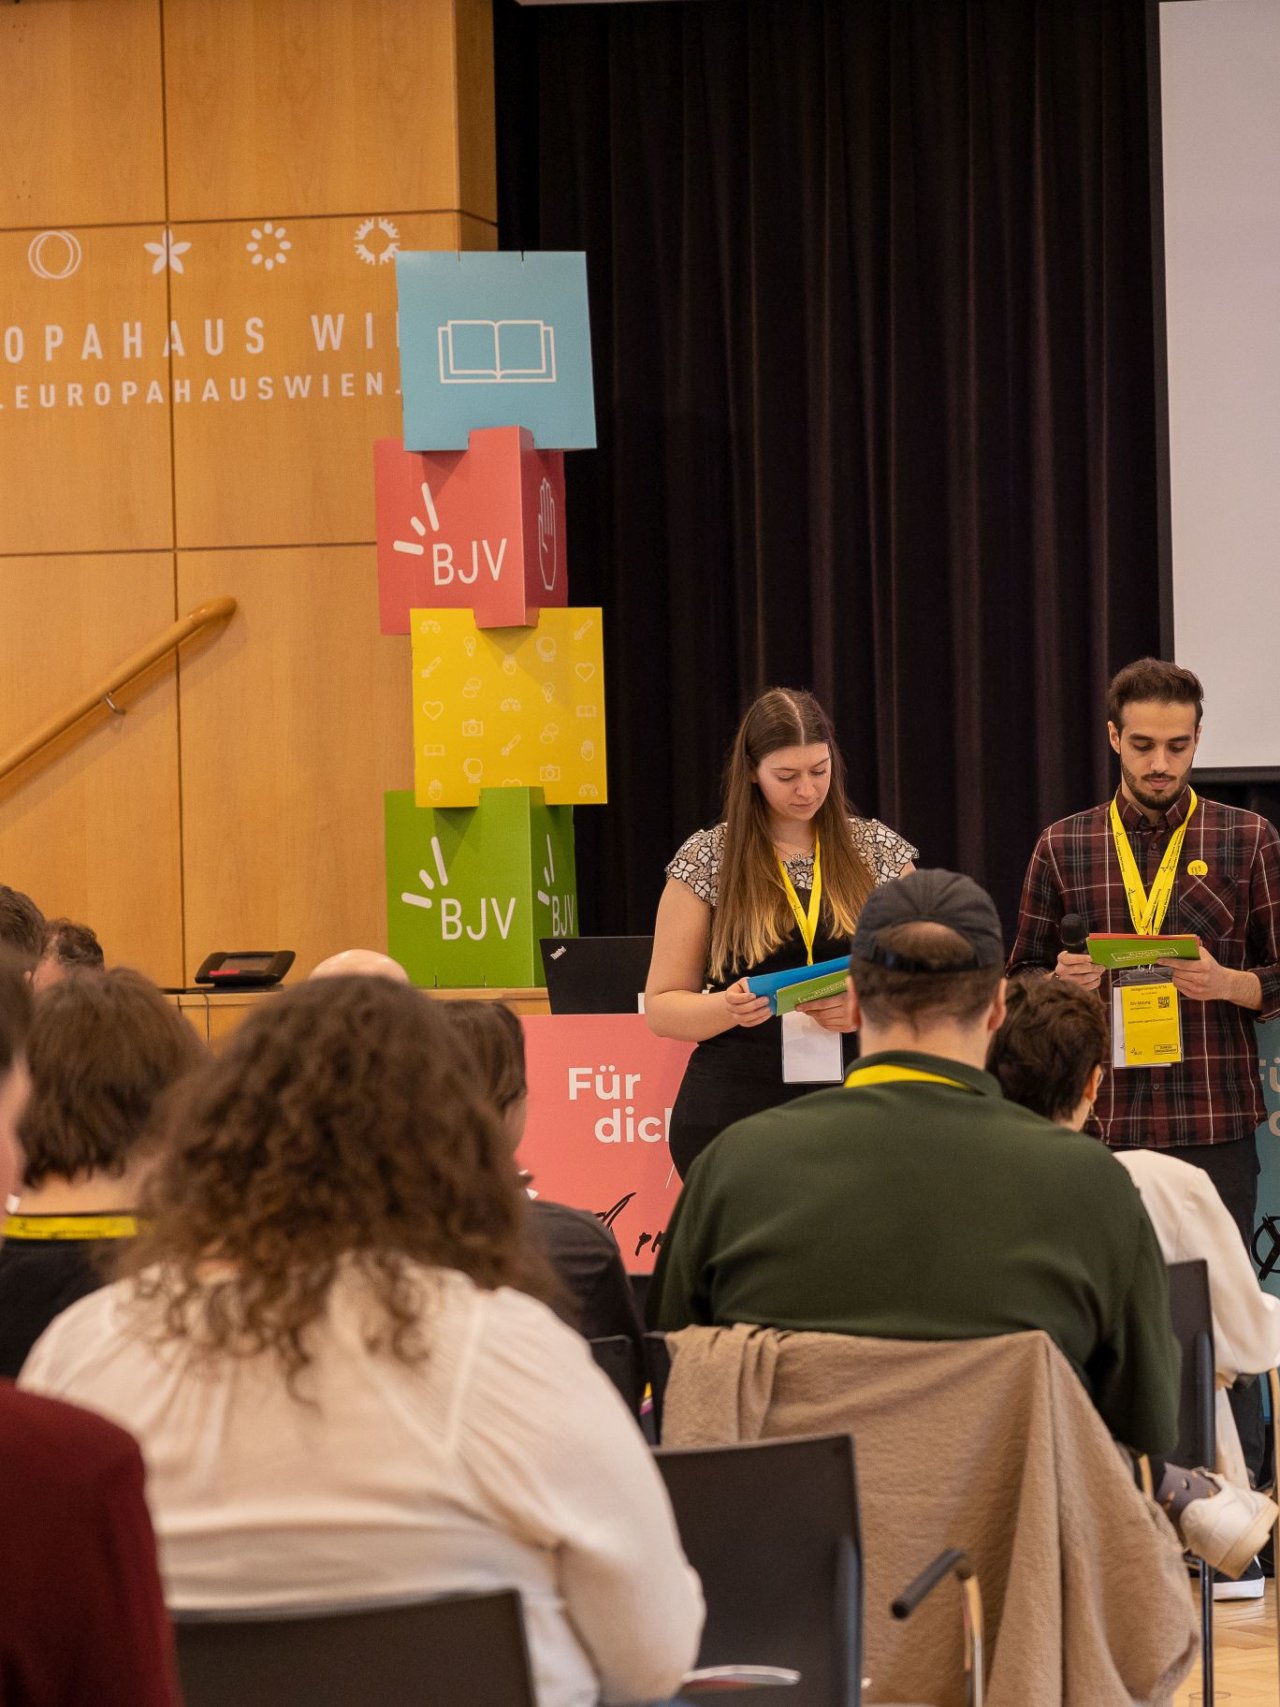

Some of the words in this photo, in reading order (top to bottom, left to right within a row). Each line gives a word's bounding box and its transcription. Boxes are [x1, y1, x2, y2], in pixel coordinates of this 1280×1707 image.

[4, 317, 264, 363] OPAHAUS
[310, 311, 399, 352] WI
[432, 537, 507, 586] BJV
[440, 897, 517, 941] BJV
[552, 894, 575, 937] BJV
[568, 1064, 641, 1101] Für
